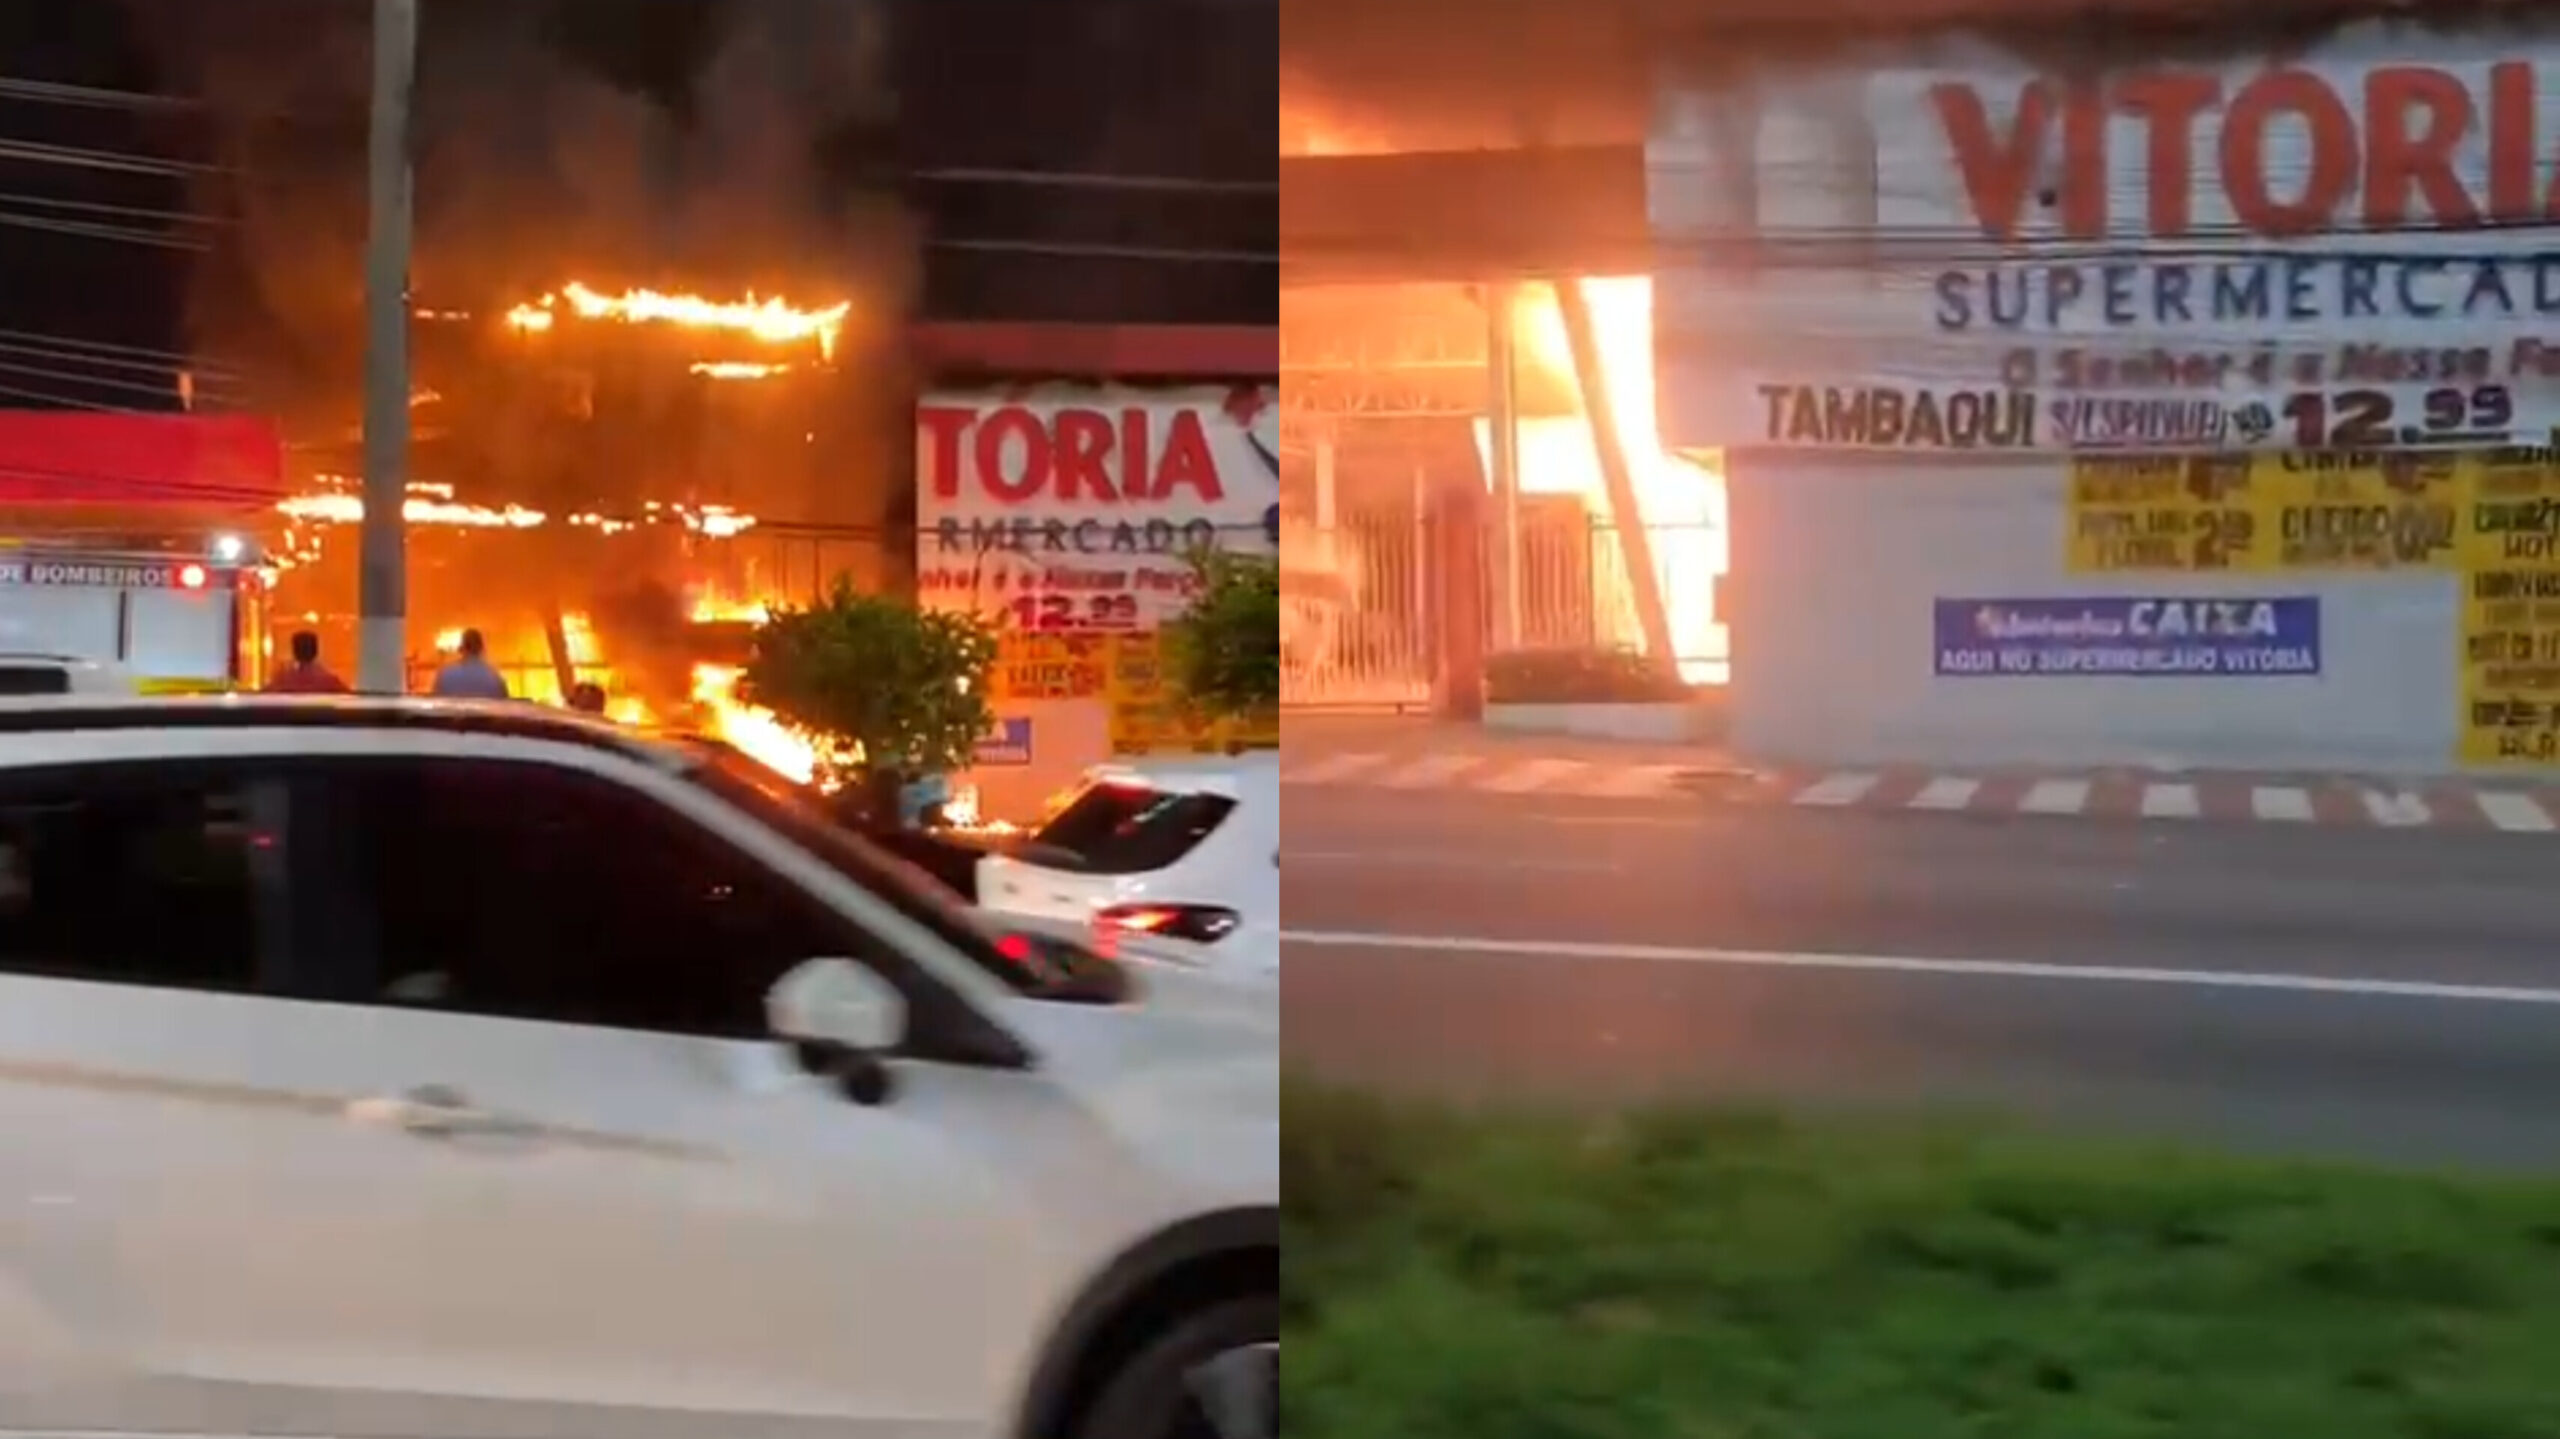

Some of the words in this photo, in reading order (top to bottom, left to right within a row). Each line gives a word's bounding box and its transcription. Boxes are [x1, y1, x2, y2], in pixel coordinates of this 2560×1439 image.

[1758, 384, 2036, 447] TAMBAQUI
[2283, 386, 2512, 447] 12.99
[2128, 601, 2277, 637] CAIXA
[1940, 648, 1994, 672] AQUI
[2037, 646, 2216, 672] SUPERMERCADO
